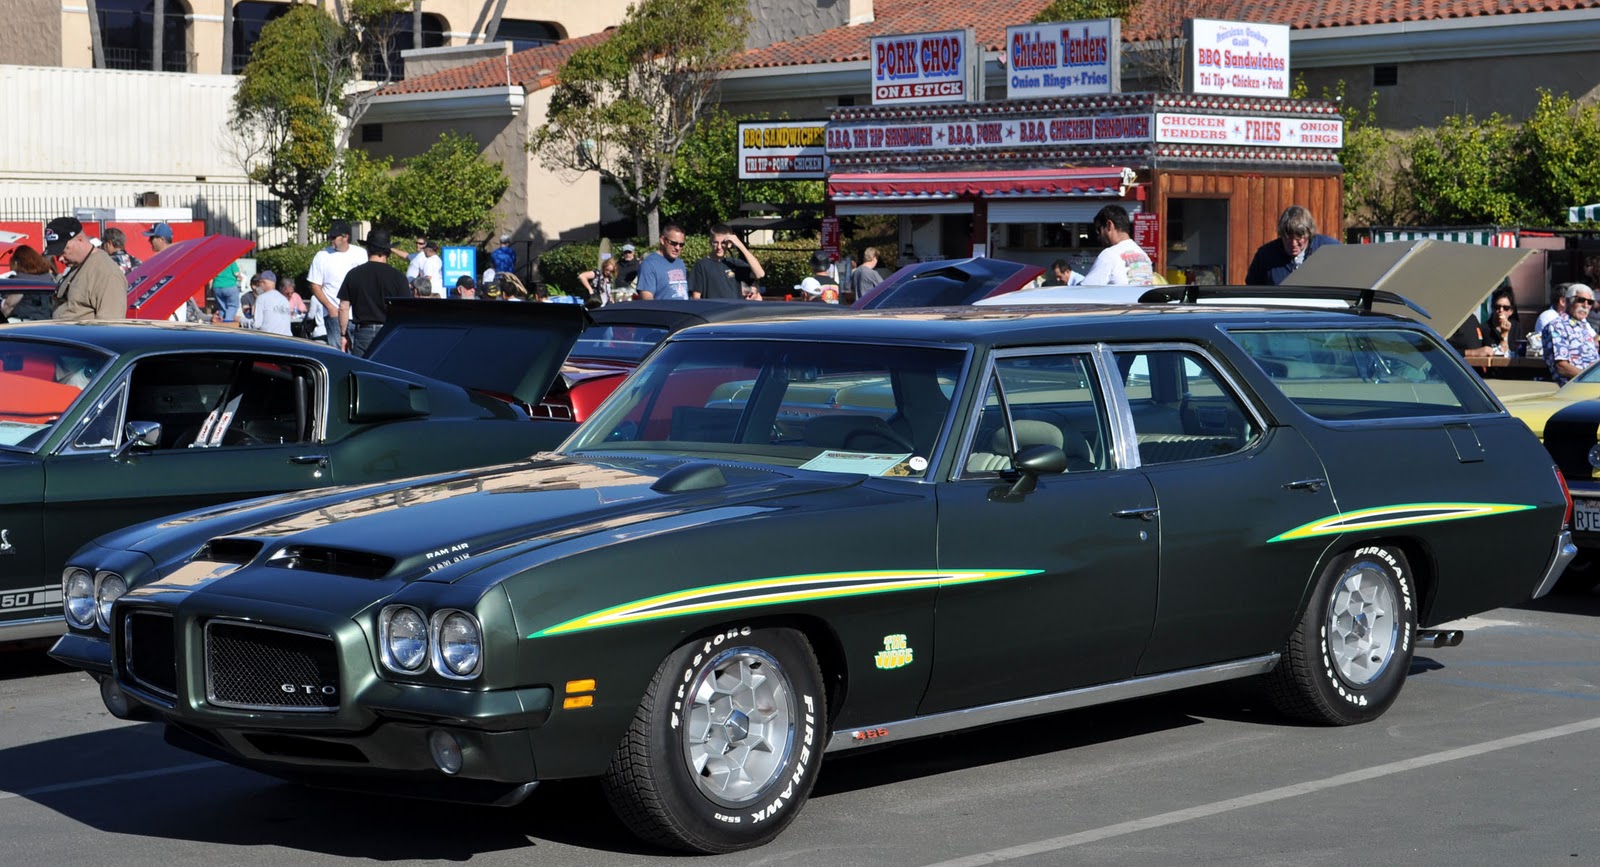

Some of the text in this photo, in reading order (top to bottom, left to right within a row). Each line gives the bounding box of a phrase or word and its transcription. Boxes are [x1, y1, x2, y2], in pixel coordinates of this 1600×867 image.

[1012, 27, 1107, 70] Chicken Tenders
[876, 36, 960, 80] PORK CHOP
[1199, 48, 1285, 71] BBQ Sandwiches
[877, 81, 962, 99] ON A STICK
[1012, 72, 1107, 90] Onion Rings Fries
[1200, 72, 1284, 90] Tri Tip Chicken Pork
[1162, 116, 1225, 127] CHICKEN
[1300, 122, 1338, 132] ONION
[743, 126, 825, 150] BBQ SANDWICHES
[853, 128, 868, 149] TRI
[868, 128, 884, 148] TIP
[885, 126, 933, 148] SANDWICH
[976, 123, 1003, 144] PORK
[1050, 118, 1094, 141] CHICKEN
[1094, 116, 1150, 138] SANDWICH
[1161, 128, 1227, 140] TENDERS
[1245, 120, 1281, 142] FRIES
[1301, 133, 1338, 143] RINGS
[746, 157, 822, 171] TRI TIP PORK CHICKEN
[426, 542, 469, 560] RAM AIR
[1354, 546, 1411, 612] FIREHAWK
[883, 634, 907, 650] THE
[874, 648, 914, 669] JUDGE
[281, 683, 336, 695] GTO
[852, 727, 889, 740] 455
[751, 694, 814, 824] FIREHAWK
